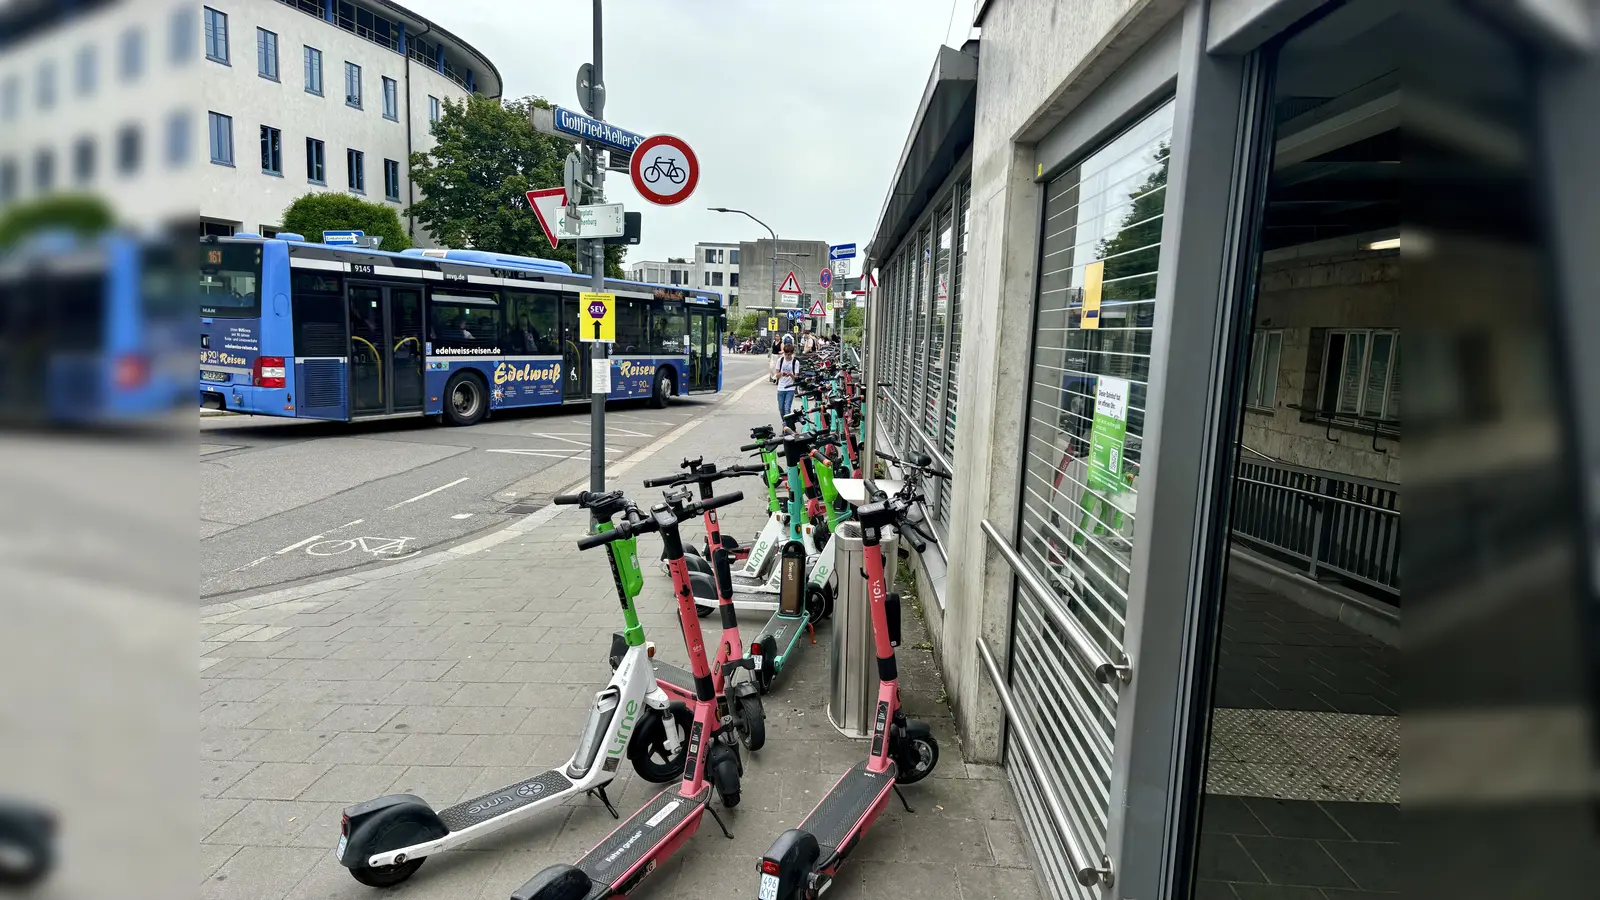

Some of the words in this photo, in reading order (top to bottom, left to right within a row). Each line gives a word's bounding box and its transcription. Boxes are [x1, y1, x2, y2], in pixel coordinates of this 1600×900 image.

[354, 265, 371, 273] 9145
[590, 305, 605, 313] SEV
[435, 347, 501, 355] edelweiss-reisen.de
[219, 353, 246, 365] Reisen
[494, 362, 561, 384] Edelweiß
[620, 361, 656, 378] Reisen
[748, 540, 769, 567] Lime
[608, 699, 638, 755] Lime
[468, 795, 513, 814] Lime
[605, 847, 625, 862] Fahre
[763, 876, 777, 889] 496
